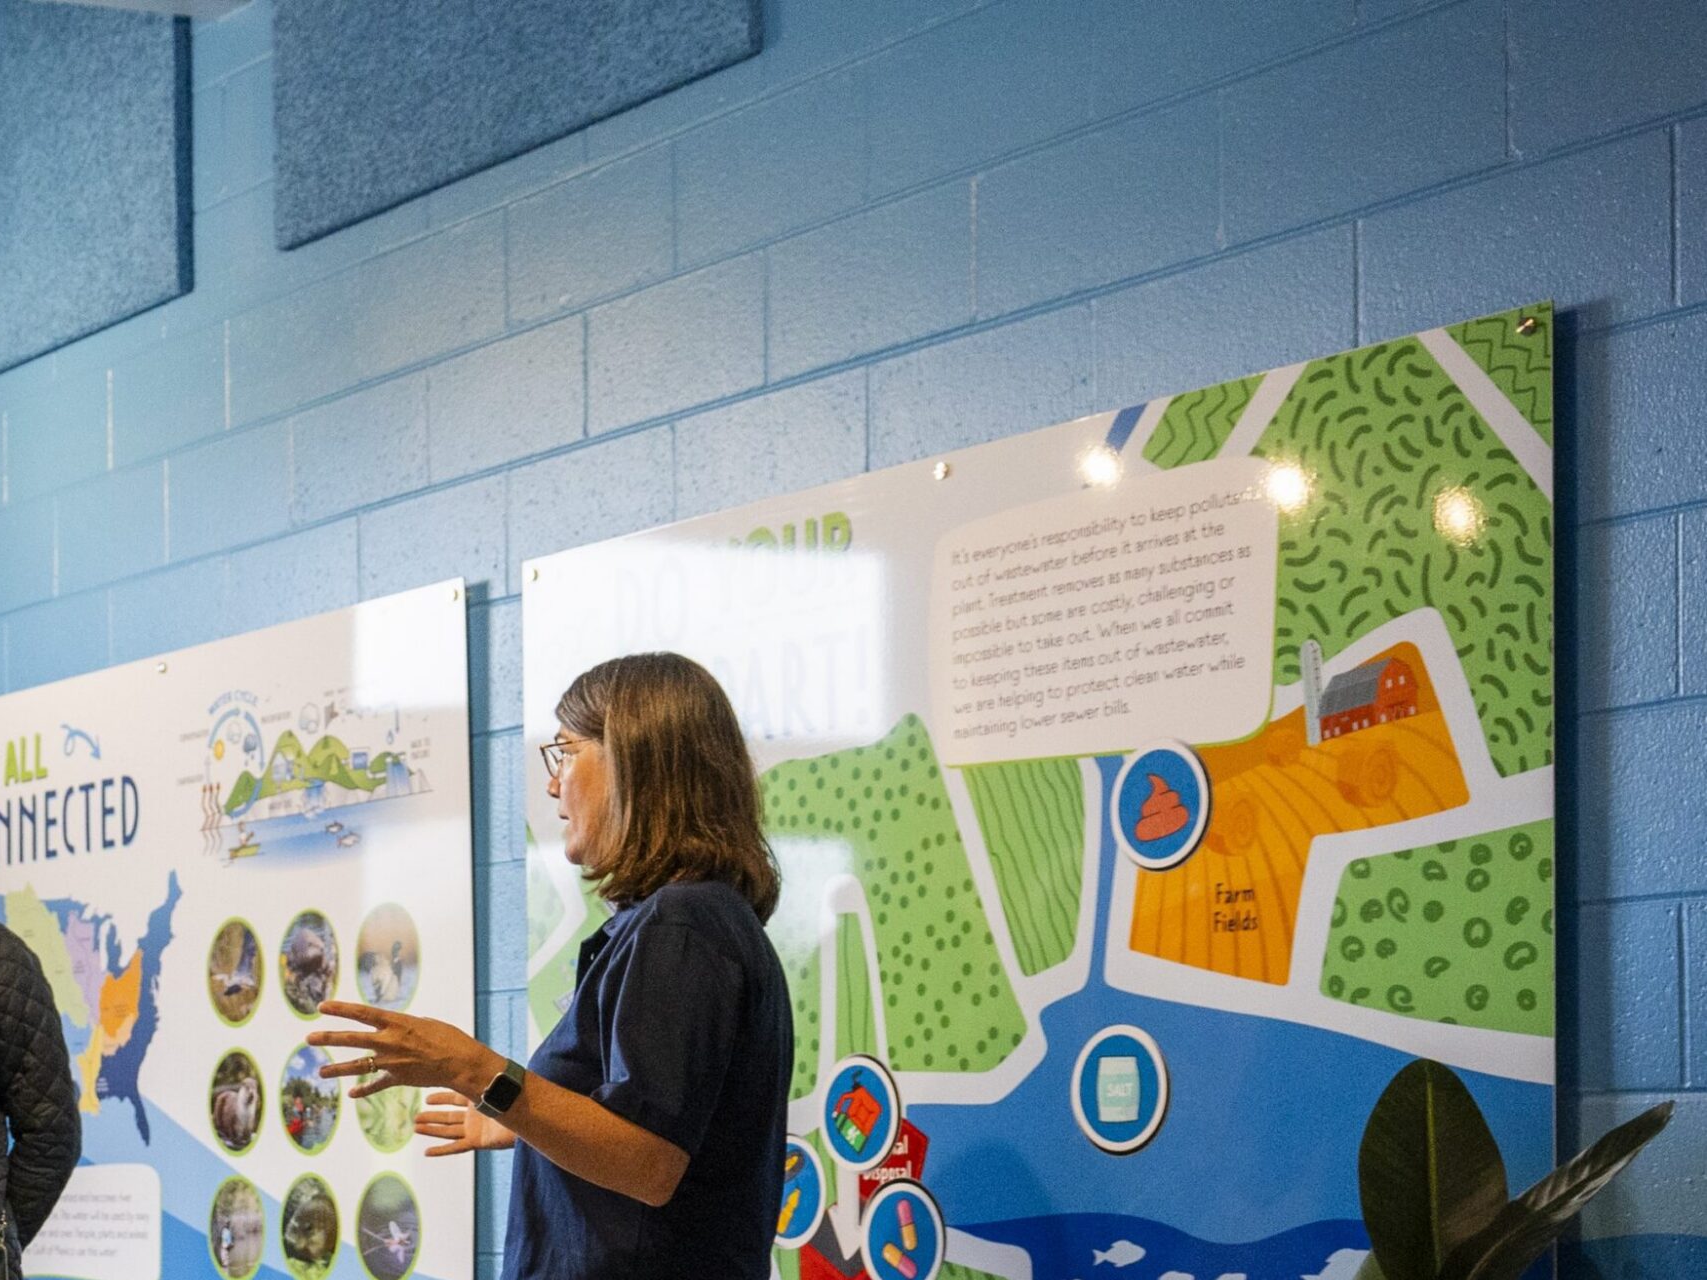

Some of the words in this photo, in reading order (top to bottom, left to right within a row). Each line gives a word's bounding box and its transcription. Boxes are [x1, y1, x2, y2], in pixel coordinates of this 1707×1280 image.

[952, 549, 970, 565] It's
[971, 534, 1038, 561] everyone's
[1041, 517, 1127, 546] responsibility
[1130, 512, 1147, 526] to
[1150, 504, 1186, 522] keep
[952, 575, 973, 591] out
[977, 567, 991, 586] of
[995, 554, 1069, 581] wastewater
[1071, 545, 1117, 567] before
[1122, 541, 1132, 556] it
[1136, 532, 1178, 554] arrives
[1184, 528, 1198, 543] at
[1201, 521, 1224, 538] the
[953, 599, 984, 617] plant.
[988, 586, 1049, 608] Treatment
[1052, 574, 1104, 595] removes
[1109, 571, 1121, 585] as
[1124, 565, 1155, 582] many
[1158, 548, 1235, 575] substances
[1237, 545, 1252, 559] as
[953, 617, 1003, 641] possible
[1005, 615, 1028, 631] but
[1031, 608, 1063, 627] some
[1066, 604, 1086, 618] are
[1091, 592, 1135, 615] costly,
[1137, 578, 1216, 606] challenging
[1218, 575, 1235, 590] or
[952, 675, 968, 690] to
[971, 668, 1021, 687] keeping
[1023, 661, 1059, 678] these
[1062, 654, 1094, 672] items
[1097, 650, 1122, 666] out
[1124, 641, 1142, 661] of
[1144, 631, 1230, 656] wastewater,
[953, 642, 1015, 665] impossible
[1017, 638, 1034, 653] to
[1036, 632, 1064, 650] take
[1067, 628, 1093, 645] out.
[1097, 619, 1138, 639] When
[1142, 616, 1162, 631] we
[1166, 608, 1181, 627] all
[1184, 600, 1235, 623] commit
[954, 702, 973, 714] we
[976, 697, 995, 713] are
[998, 689, 1045, 709] helping
[1047, 685, 1063, 700] to
[1066, 676, 1119, 698] protect
[1123, 670, 1160, 688] clean
[1162, 660, 1206, 681] water
[1208, 653, 1246, 672] while
[953, 718, 1017, 740] maintaining
[1019, 712, 1057, 730] lower
[1059, 706, 1099, 724] sewer
[1103, 697, 1131, 718] bills.
[4, 732, 48, 787] ALL
[1213, 910, 1259, 932] Fields
[1215, 882, 1255, 904] Farm
